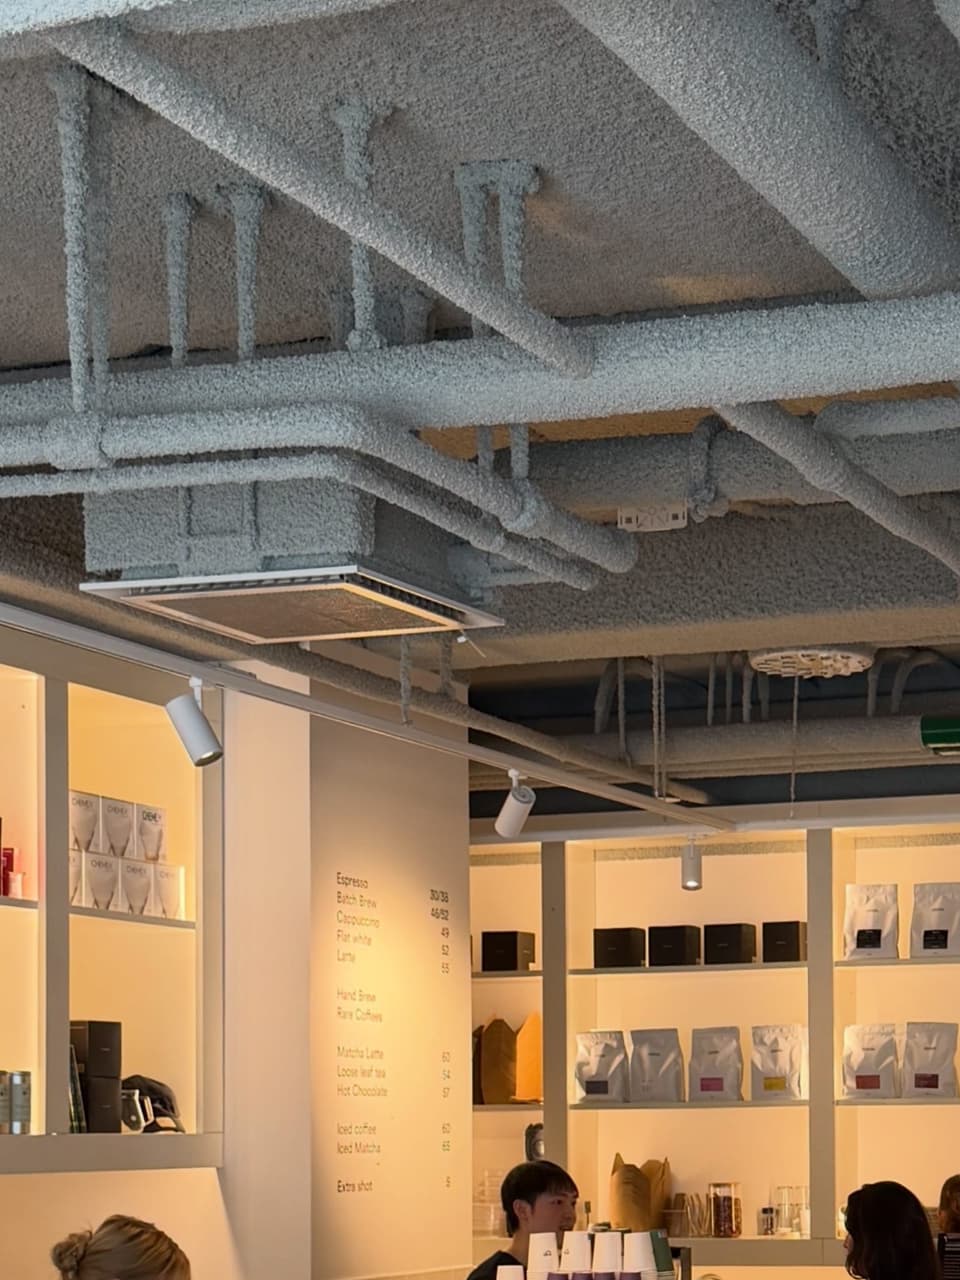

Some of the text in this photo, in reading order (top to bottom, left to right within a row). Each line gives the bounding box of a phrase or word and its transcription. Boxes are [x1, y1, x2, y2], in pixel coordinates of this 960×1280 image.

[337, 872, 369, 889] Espresso
[337, 891, 356, 905] Batch
[359, 895, 377, 909] Brew
[337, 910, 380, 929] Cappuccino
[337, 929, 350, 944] Flat
[352, 933, 372, 947] white
[337, 949, 356, 963] Latte
[337, 988, 376, 1002] Hand Brew
[337, 1046, 364, 1059] Matcha
[366, 1048, 384, 1060] Latte
[337, 1065, 358, 1078] Loose
[337, 1085, 350, 1097] Hot
[352, 1084, 388, 1097] Chocolate
[337, 1122, 353, 1136] Iced
[354, 1122, 377, 1136] coffee
[337, 1141, 353, 1154] Iced
[354, 1141, 381, 1154] Matcha
[337, 1179, 356, 1193] Extra
[357, 1180, 373, 1193] shot
